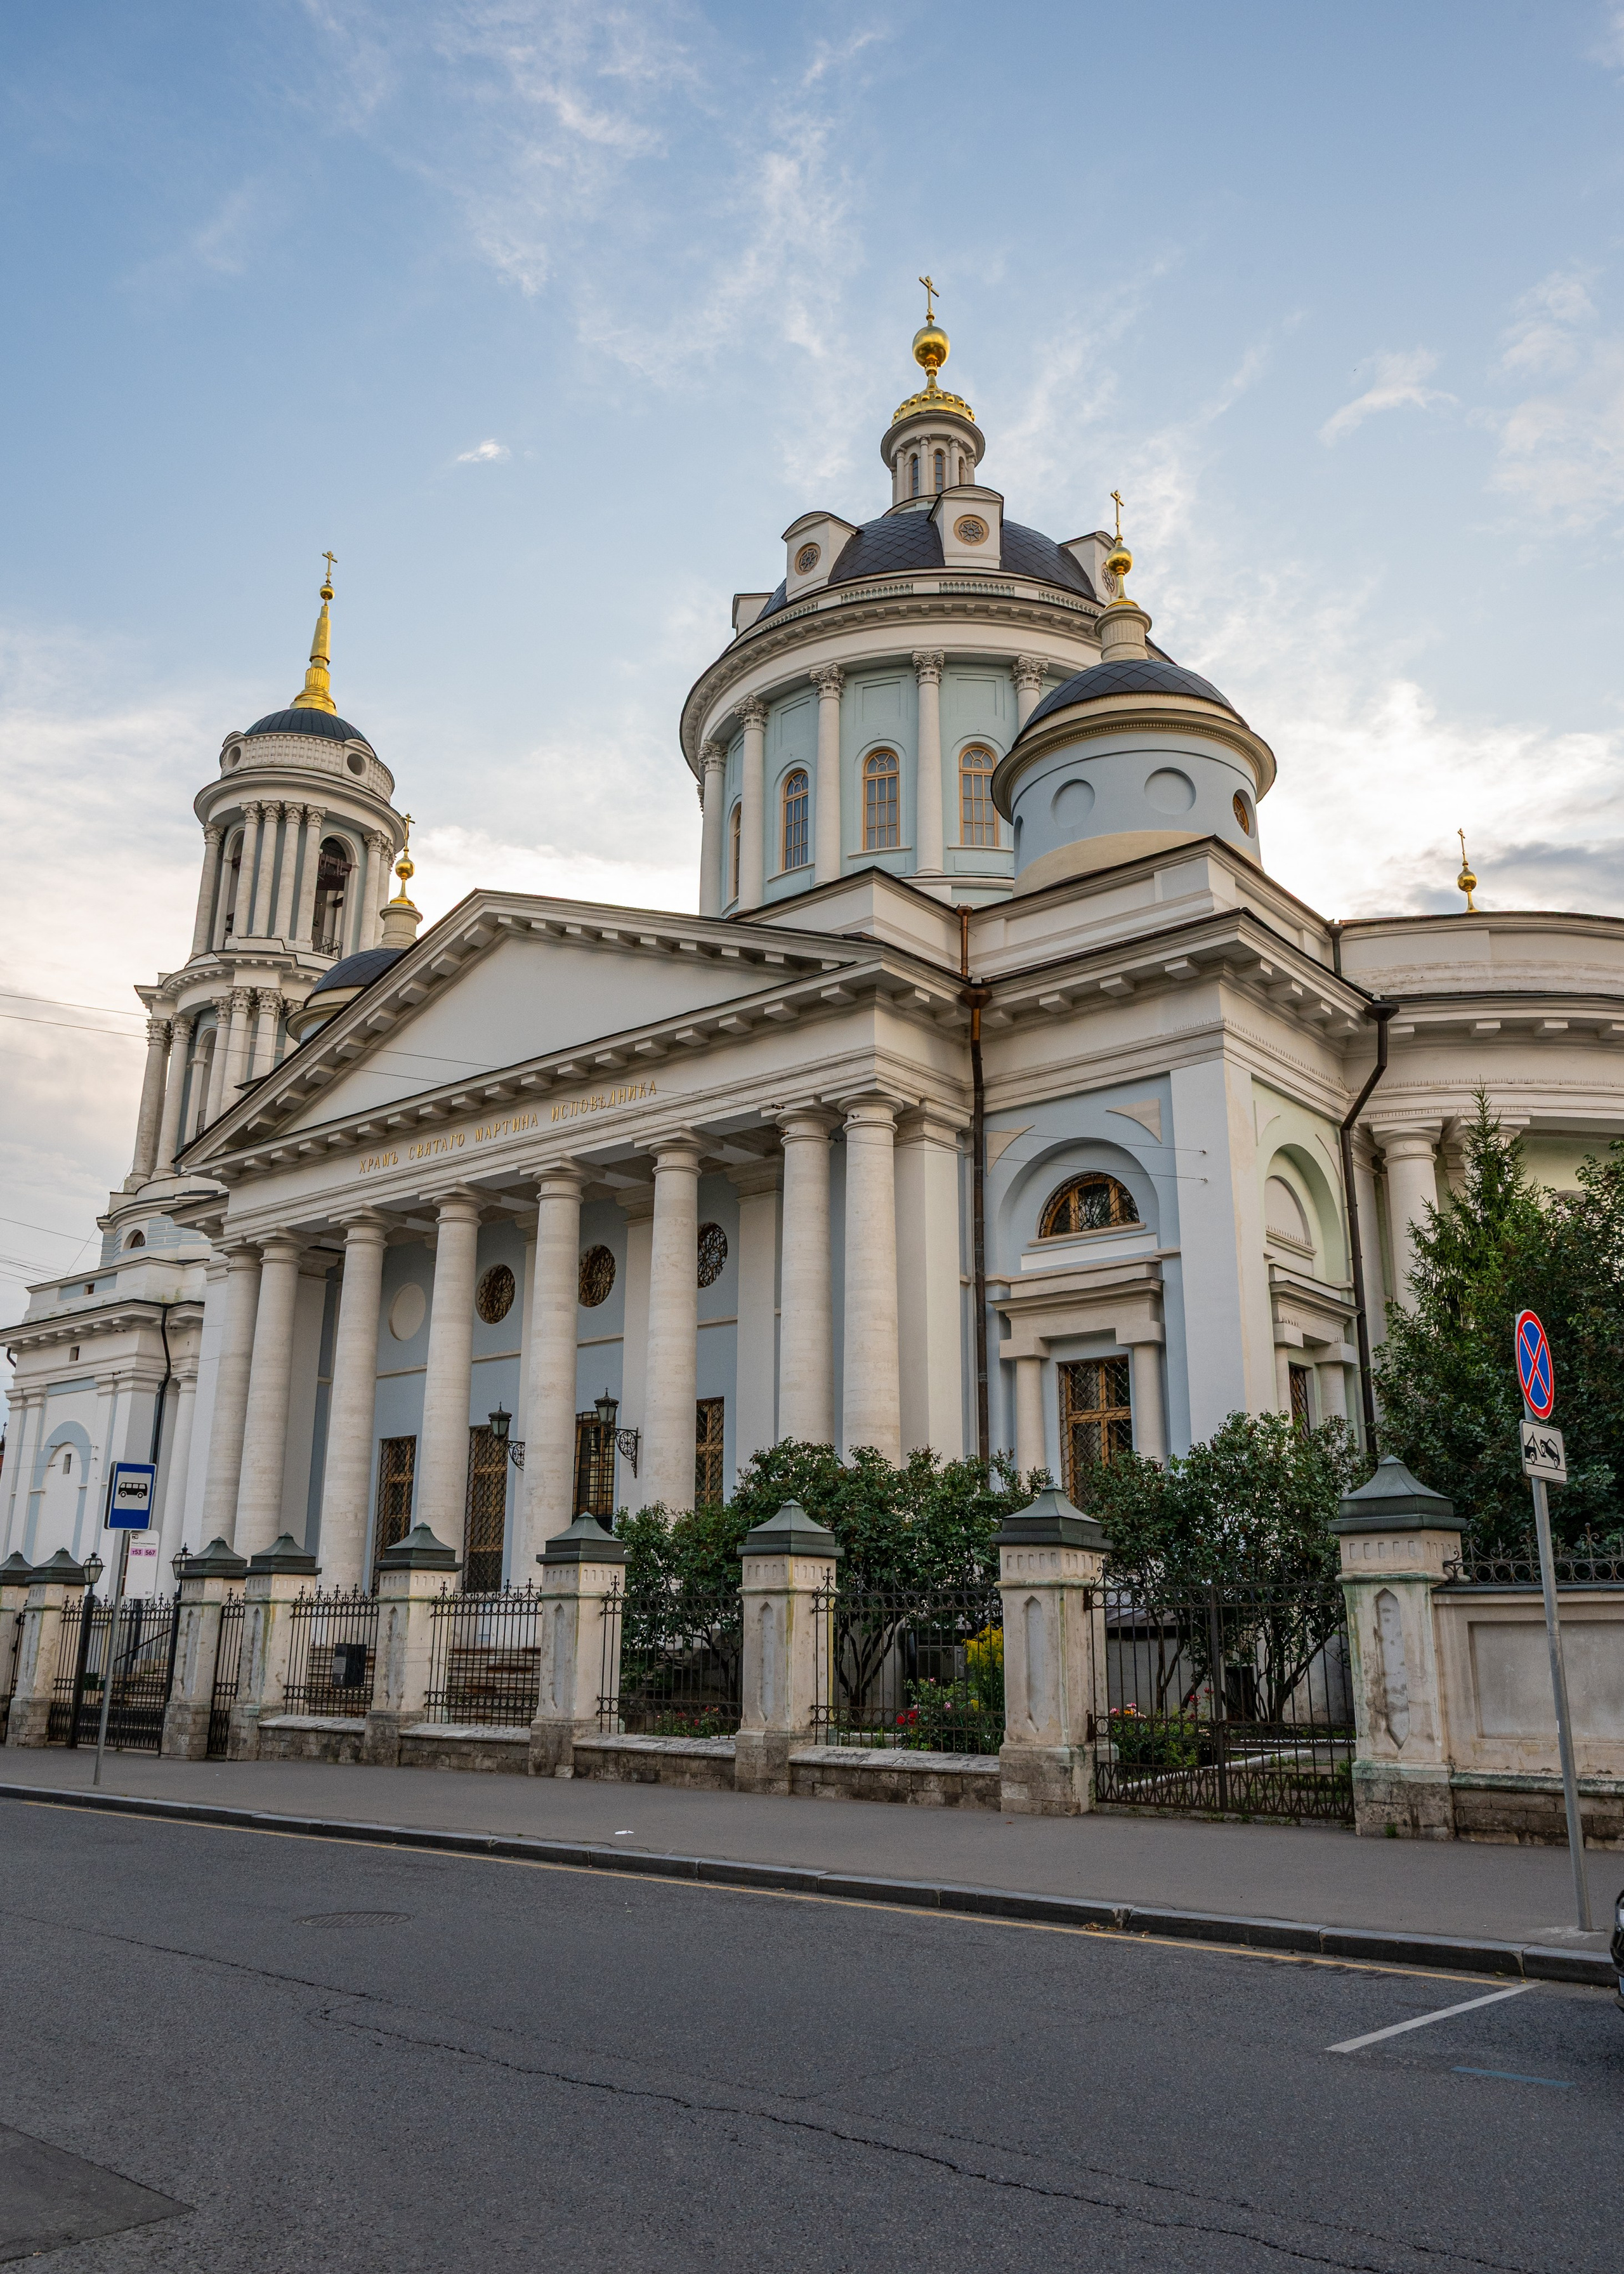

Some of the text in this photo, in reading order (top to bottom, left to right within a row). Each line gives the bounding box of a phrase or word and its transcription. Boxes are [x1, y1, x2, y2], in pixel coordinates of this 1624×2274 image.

[359, 1080, 657, 1174] ХРАМЪ СВЯТАГО МАРТИНА ИСПОВѢДНИКА
